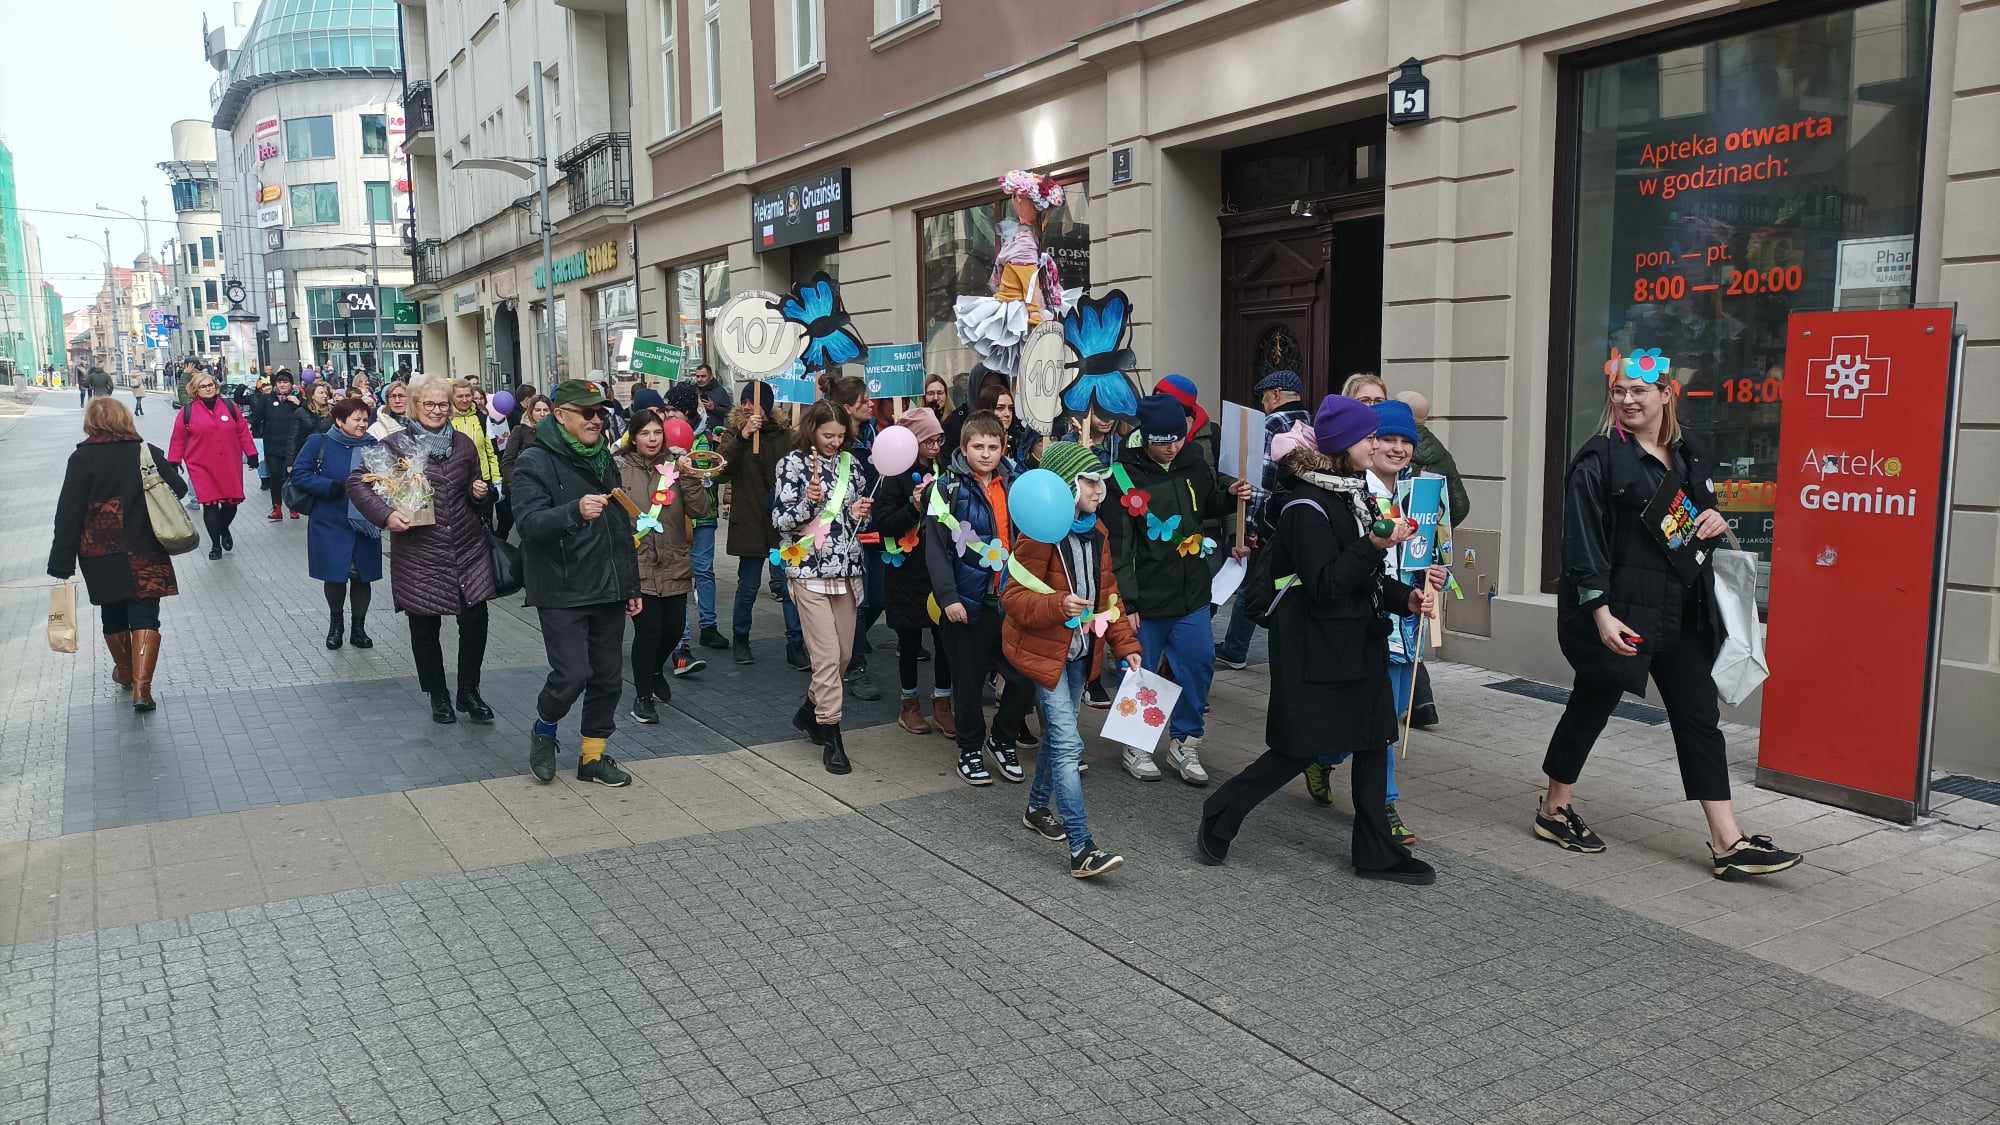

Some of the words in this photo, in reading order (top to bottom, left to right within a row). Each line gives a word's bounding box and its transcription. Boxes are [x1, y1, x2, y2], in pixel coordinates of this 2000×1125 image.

[1403, 89, 1417, 113] 5
[1639, 134, 1718, 168] Apteka
[1725, 116, 1833, 151] otwarta
[1119, 155, 1125, 167] 5
[1639, 178, 1657, 196] w
[1662, 154, 1789, 200] godzinach:
[753, 194, 784, 223] Piekarnia
[802, 177, 841, 210] Gruzińska
[585, 240, 617, 275] STORE
[1635, 250, 1676, 273] pon.
[1706, 243, 1733, 267] pt.
[1633, 275, 1686, 302] 8:00
[1726, 264, 1803, 297] 20:00
[726, 316, 787, 355] 107
[866, 364, 905, 374] WIECZNIE
[1722, 378, 1782, 403] 18:0
[1800, 484, 1917, 517] Gemini
